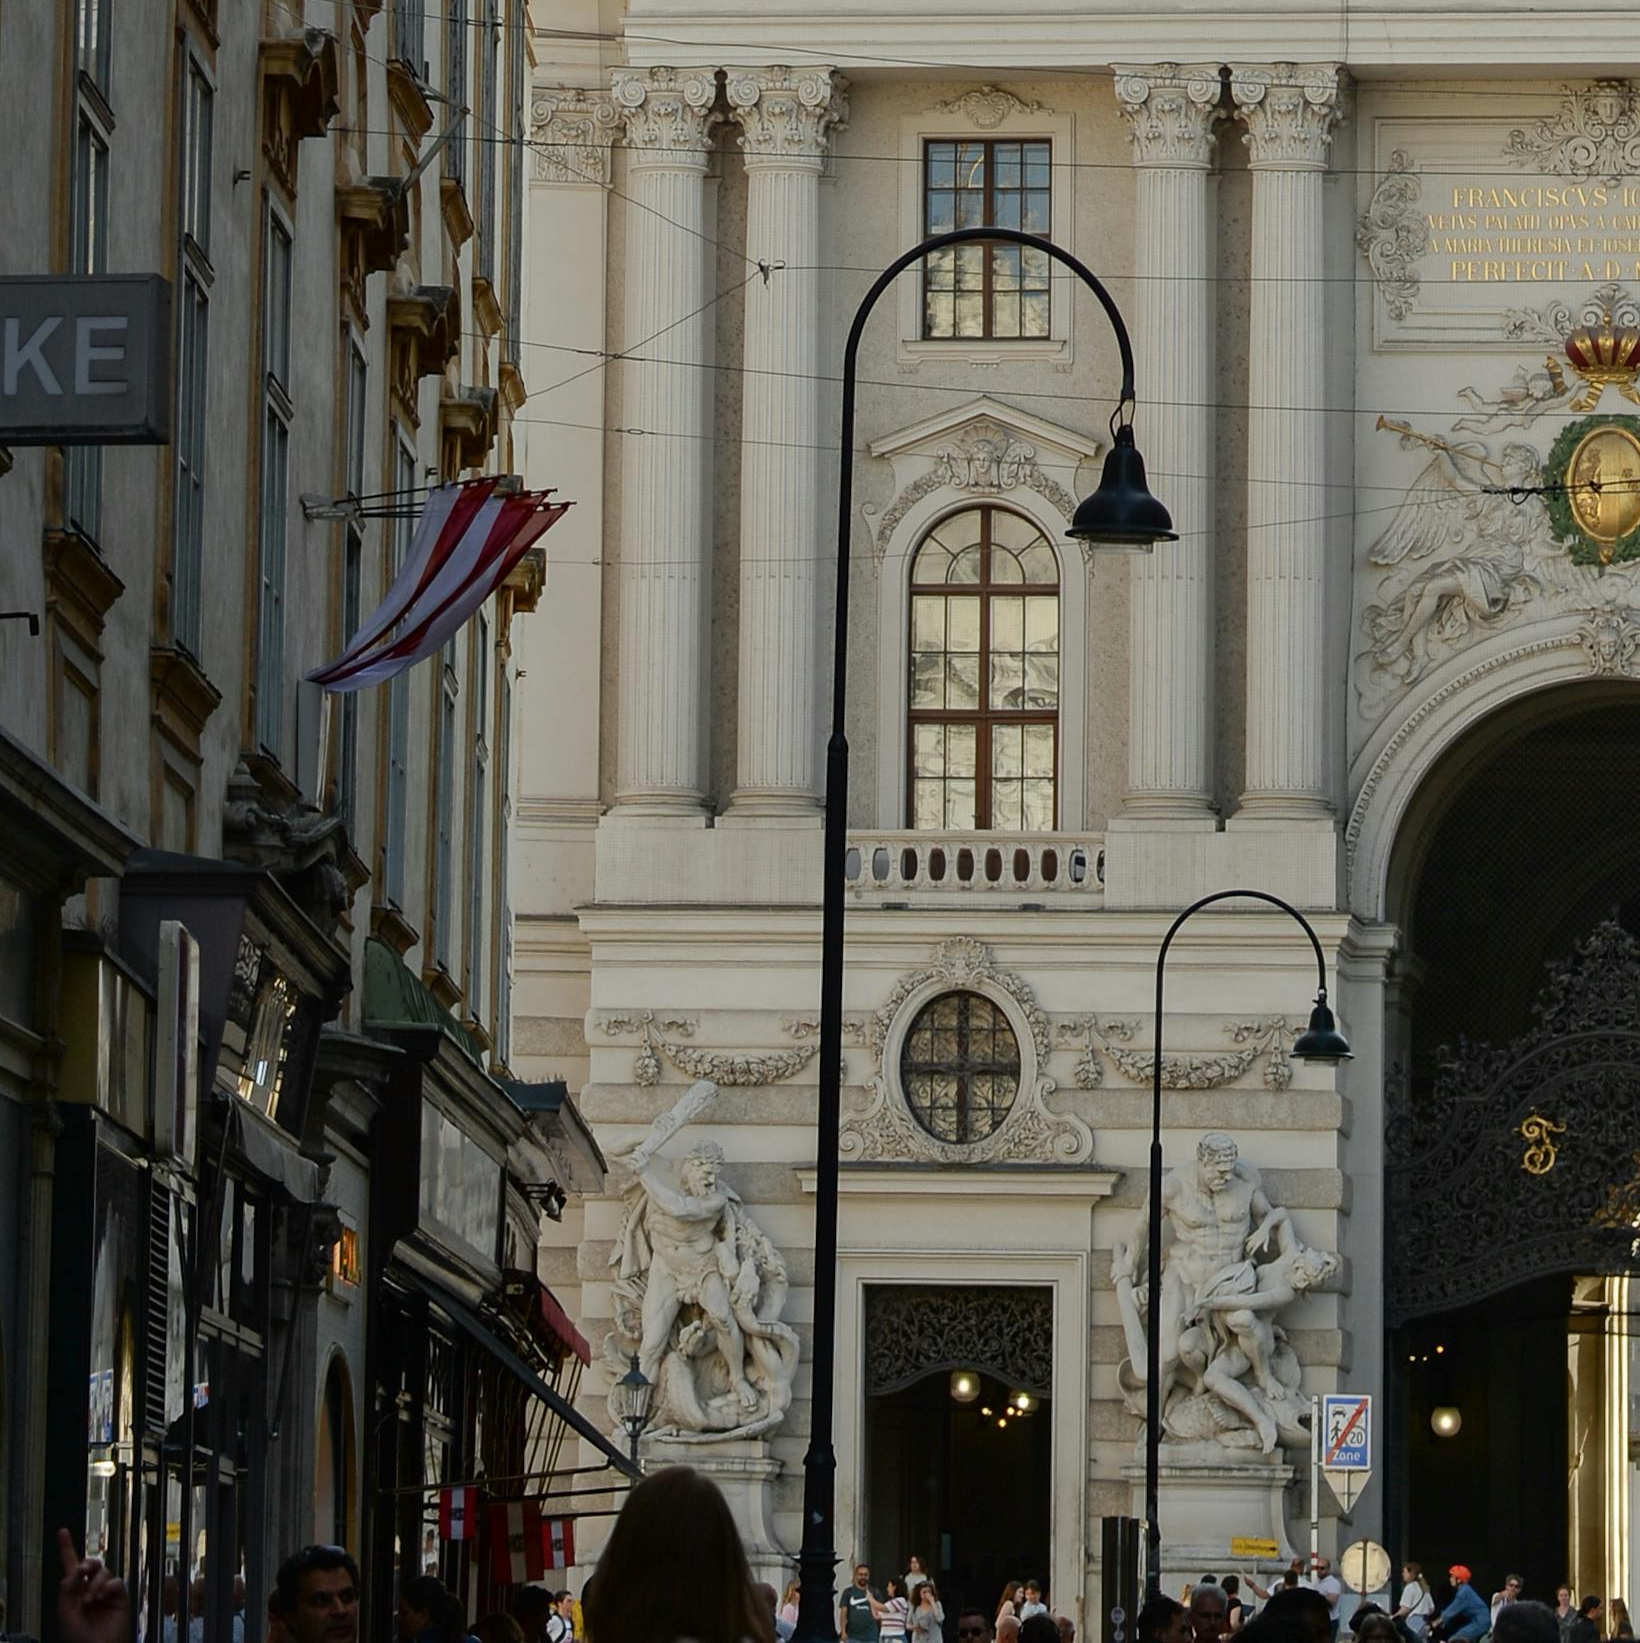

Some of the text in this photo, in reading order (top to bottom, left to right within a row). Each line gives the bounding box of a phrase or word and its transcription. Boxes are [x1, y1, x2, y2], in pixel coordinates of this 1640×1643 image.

[1453, 187, 1608, 208] FRANCISCVS
[1428, 214, 1477, 230] VETVS
[1549, 214, 1589, 230] OPVS
[1445, 238, 1492, 253] MARIA
[1498, 238, 1572, 253] THERESIA
[1452, 261, 1568, 281] PERFECIT
[1349, 1431, 1363, 1444] 20
[1334, 1450, 1361, 1461] Zone
